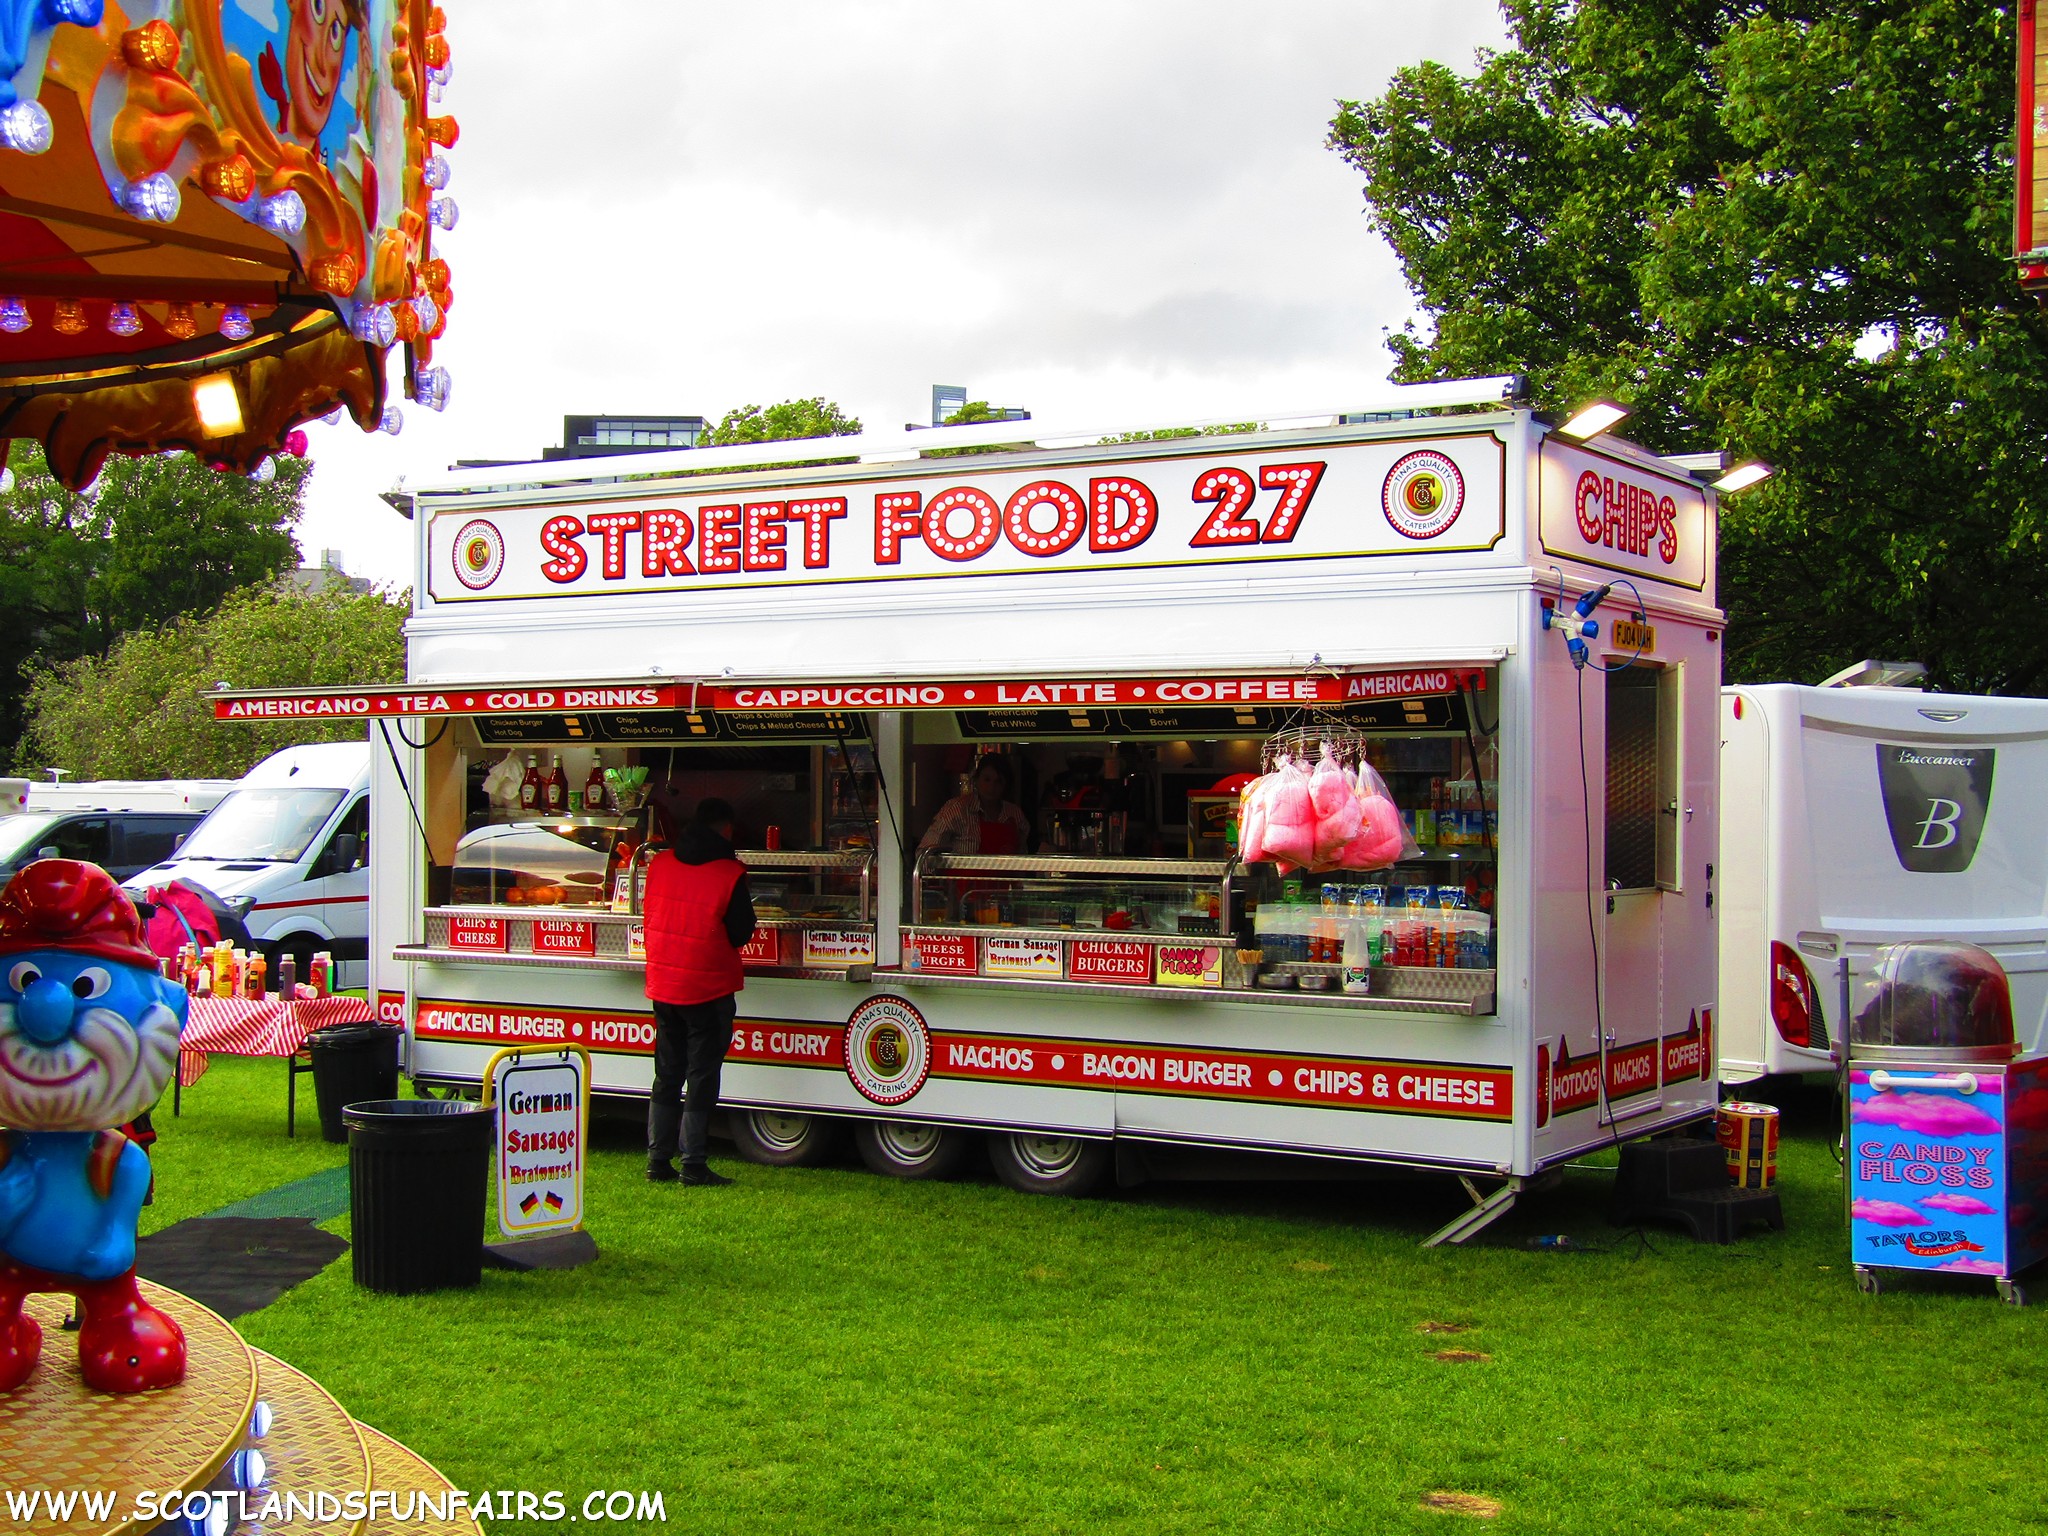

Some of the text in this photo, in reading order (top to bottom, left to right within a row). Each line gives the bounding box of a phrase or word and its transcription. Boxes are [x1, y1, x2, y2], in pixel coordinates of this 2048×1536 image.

[1395, 459, 1452, 482] TINA'S QUALITY
[540, 461, 1328, 583] STREET FOOD 27
[1404, 517, 1441, 530] CATERING
[1575, 470, 1678, 564] CHIPS
[475, 526, 497, 543] QUALITY
[466, 573, 491, 583] CATERING
[1347, 672, 1448, 698] AMERICANO
[735, 680, 1318, 707] CAPPUCCINO LATTE COFFEE
[229, 689, 659, 716] AMERICANO TEA COLD DRINKS
[490, 718, 544, 728] Chicken Burger
[616, 716, 639, 725] Chips
[736, 720, 826, 731] Chips & Melted Cheese
[991, 719, 1037, 728] Flat White
[1150, 718, 1178, 727] Bovril
[494, 729, 523, 738] Hot Dog
[620, 726, 674, 736] Chips & Curry
[1898, 749, 1975, 767] Buccaneer
[1912, 798, 1961, 849] B
[456, 918, 498, 929] CHIPS &
[540, 921, 585, 933] CHIPS &
[457, 932, 498, 945] CHEESE
[543, 935, 582, 948] CURRY
[808, 930, 870, 945] German Sausage
[988, 937, 1059, 953] German Sausage
[808, 943, 847, 958] Bratwurst
[1078, 941, 1145, 956] CHICKEN
[1159, 947, 1204, 962] CANDY
[990, 953, 1032, 967] Bratwurst
[1077, 957, 1145, 973] BURGERS
[1161, 961, 1203, 976] FLOSS
[856, 1005, 920, 1034] TINA'S QUALITY
[427, 1010, 494, 1034] CHICKEN
[500, 1015, 565, 1038] BURGER
[591, 1021, 656, 1044] HOTDO
[751, 1031, 764, 1051] &
[769, 1033, 830, 1056] CURRY
[1667, 1042, 1699, 1071] COFFEE
[949, 1044, 1495, 1106] NACHOS BACON BURGER CHIPS & CHEESE
[1613, 1055, 1650, 1085] NACHOS
[866, 1079, 907, 1093] CATERING
[1553, 1067, 1598, 1101] HOTDOG
[509, 1090, 573, 1115] German
[507, 1129, 576, 1154] Sausage
[1858, 1141, 1994, 1166] CANDY
[510, 1161, 572, 1185] Bratwurst
[1859, 1160, 1994, 1189] FLOSS
[1866, 1230, 1968, 1248] TAYLORS
[1918, 1243, 1964, 1255] Edinburgh
